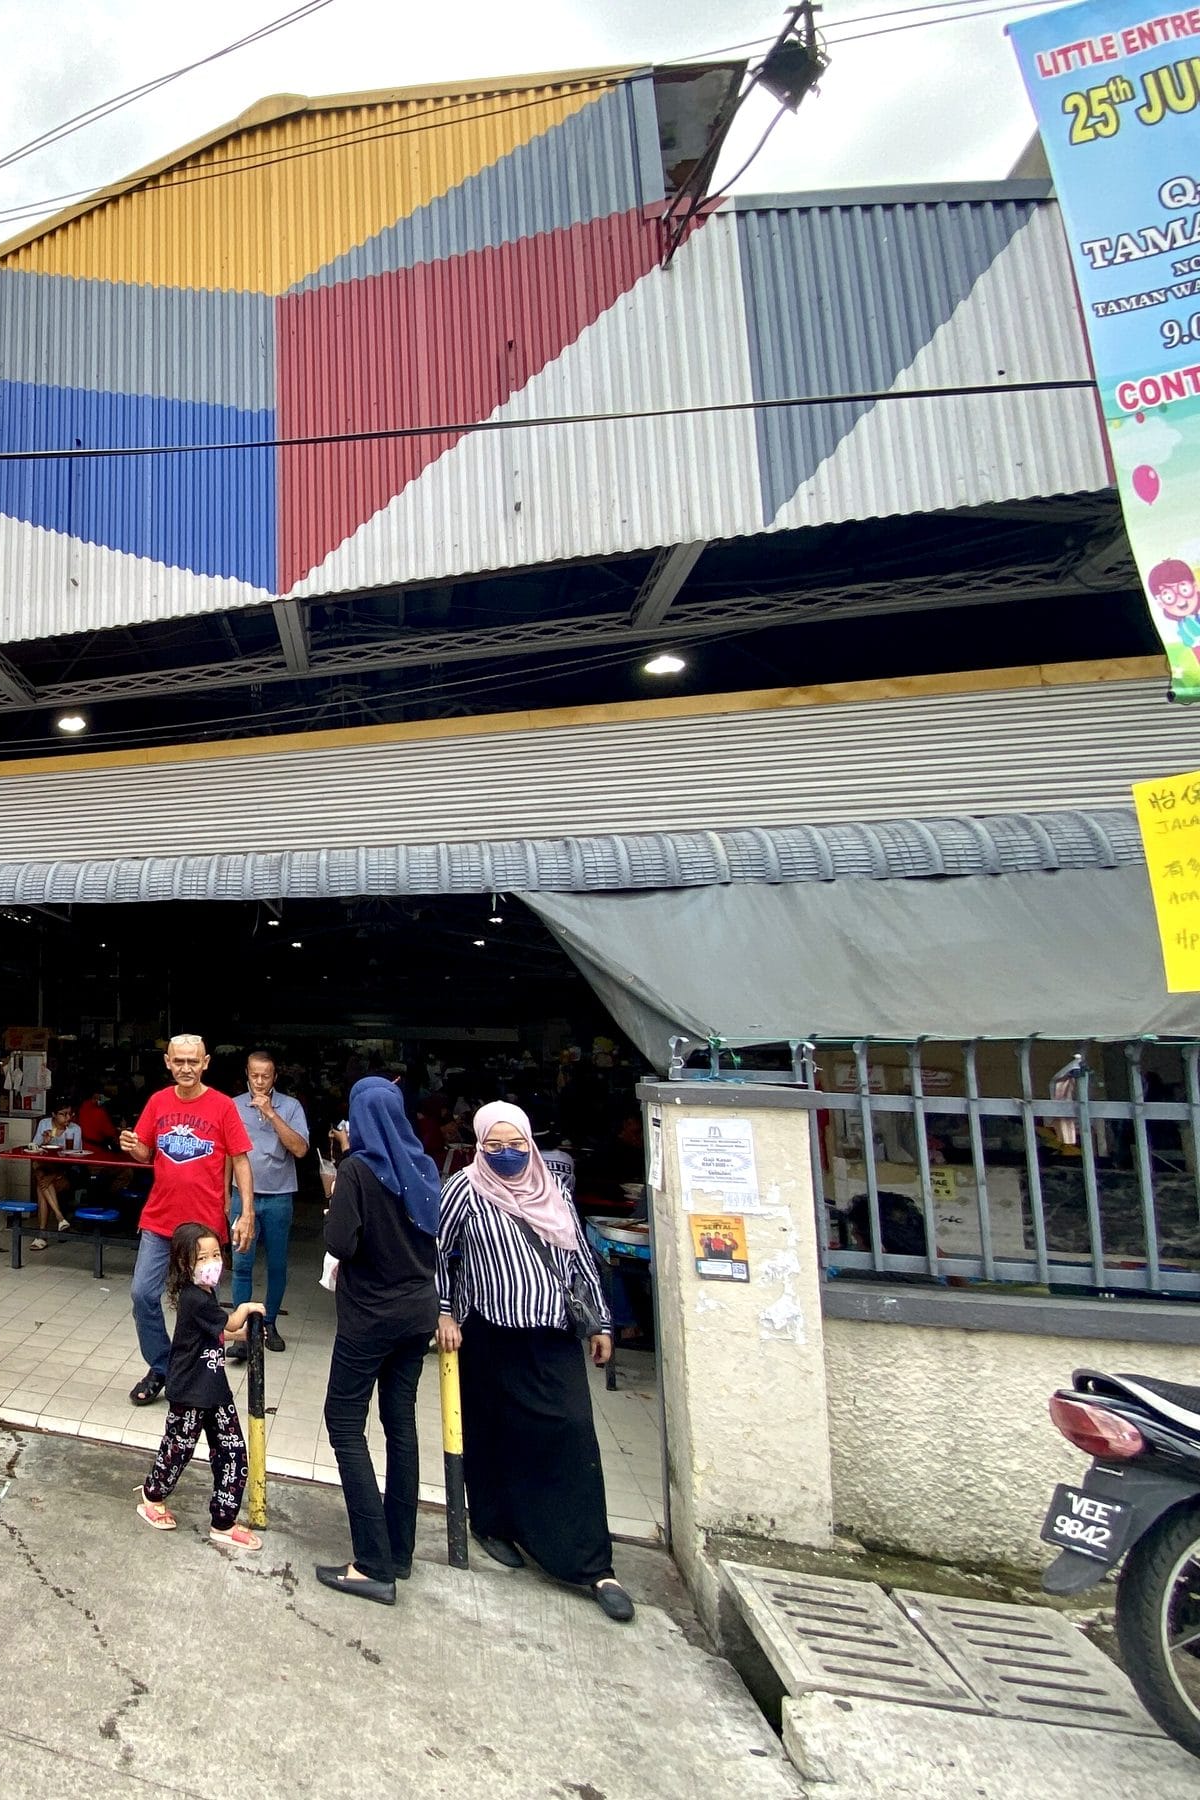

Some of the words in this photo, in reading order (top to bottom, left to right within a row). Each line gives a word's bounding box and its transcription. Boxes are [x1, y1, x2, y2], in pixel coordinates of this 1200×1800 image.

[1036, 34, 1119, 78] LITTLE
[1121, 8, 1200, 55] ENTRE
[1062, 75, 1136, 146] 25th
[1135, 56, 1200, 126] JU
[1092, 288, 1168, 317] TAMAN
[1117, 366, 1200, 411] CONT
[1071, 1495, 1113, 1525] VEE
[1053, 1515, 1111, 1549] 9842
